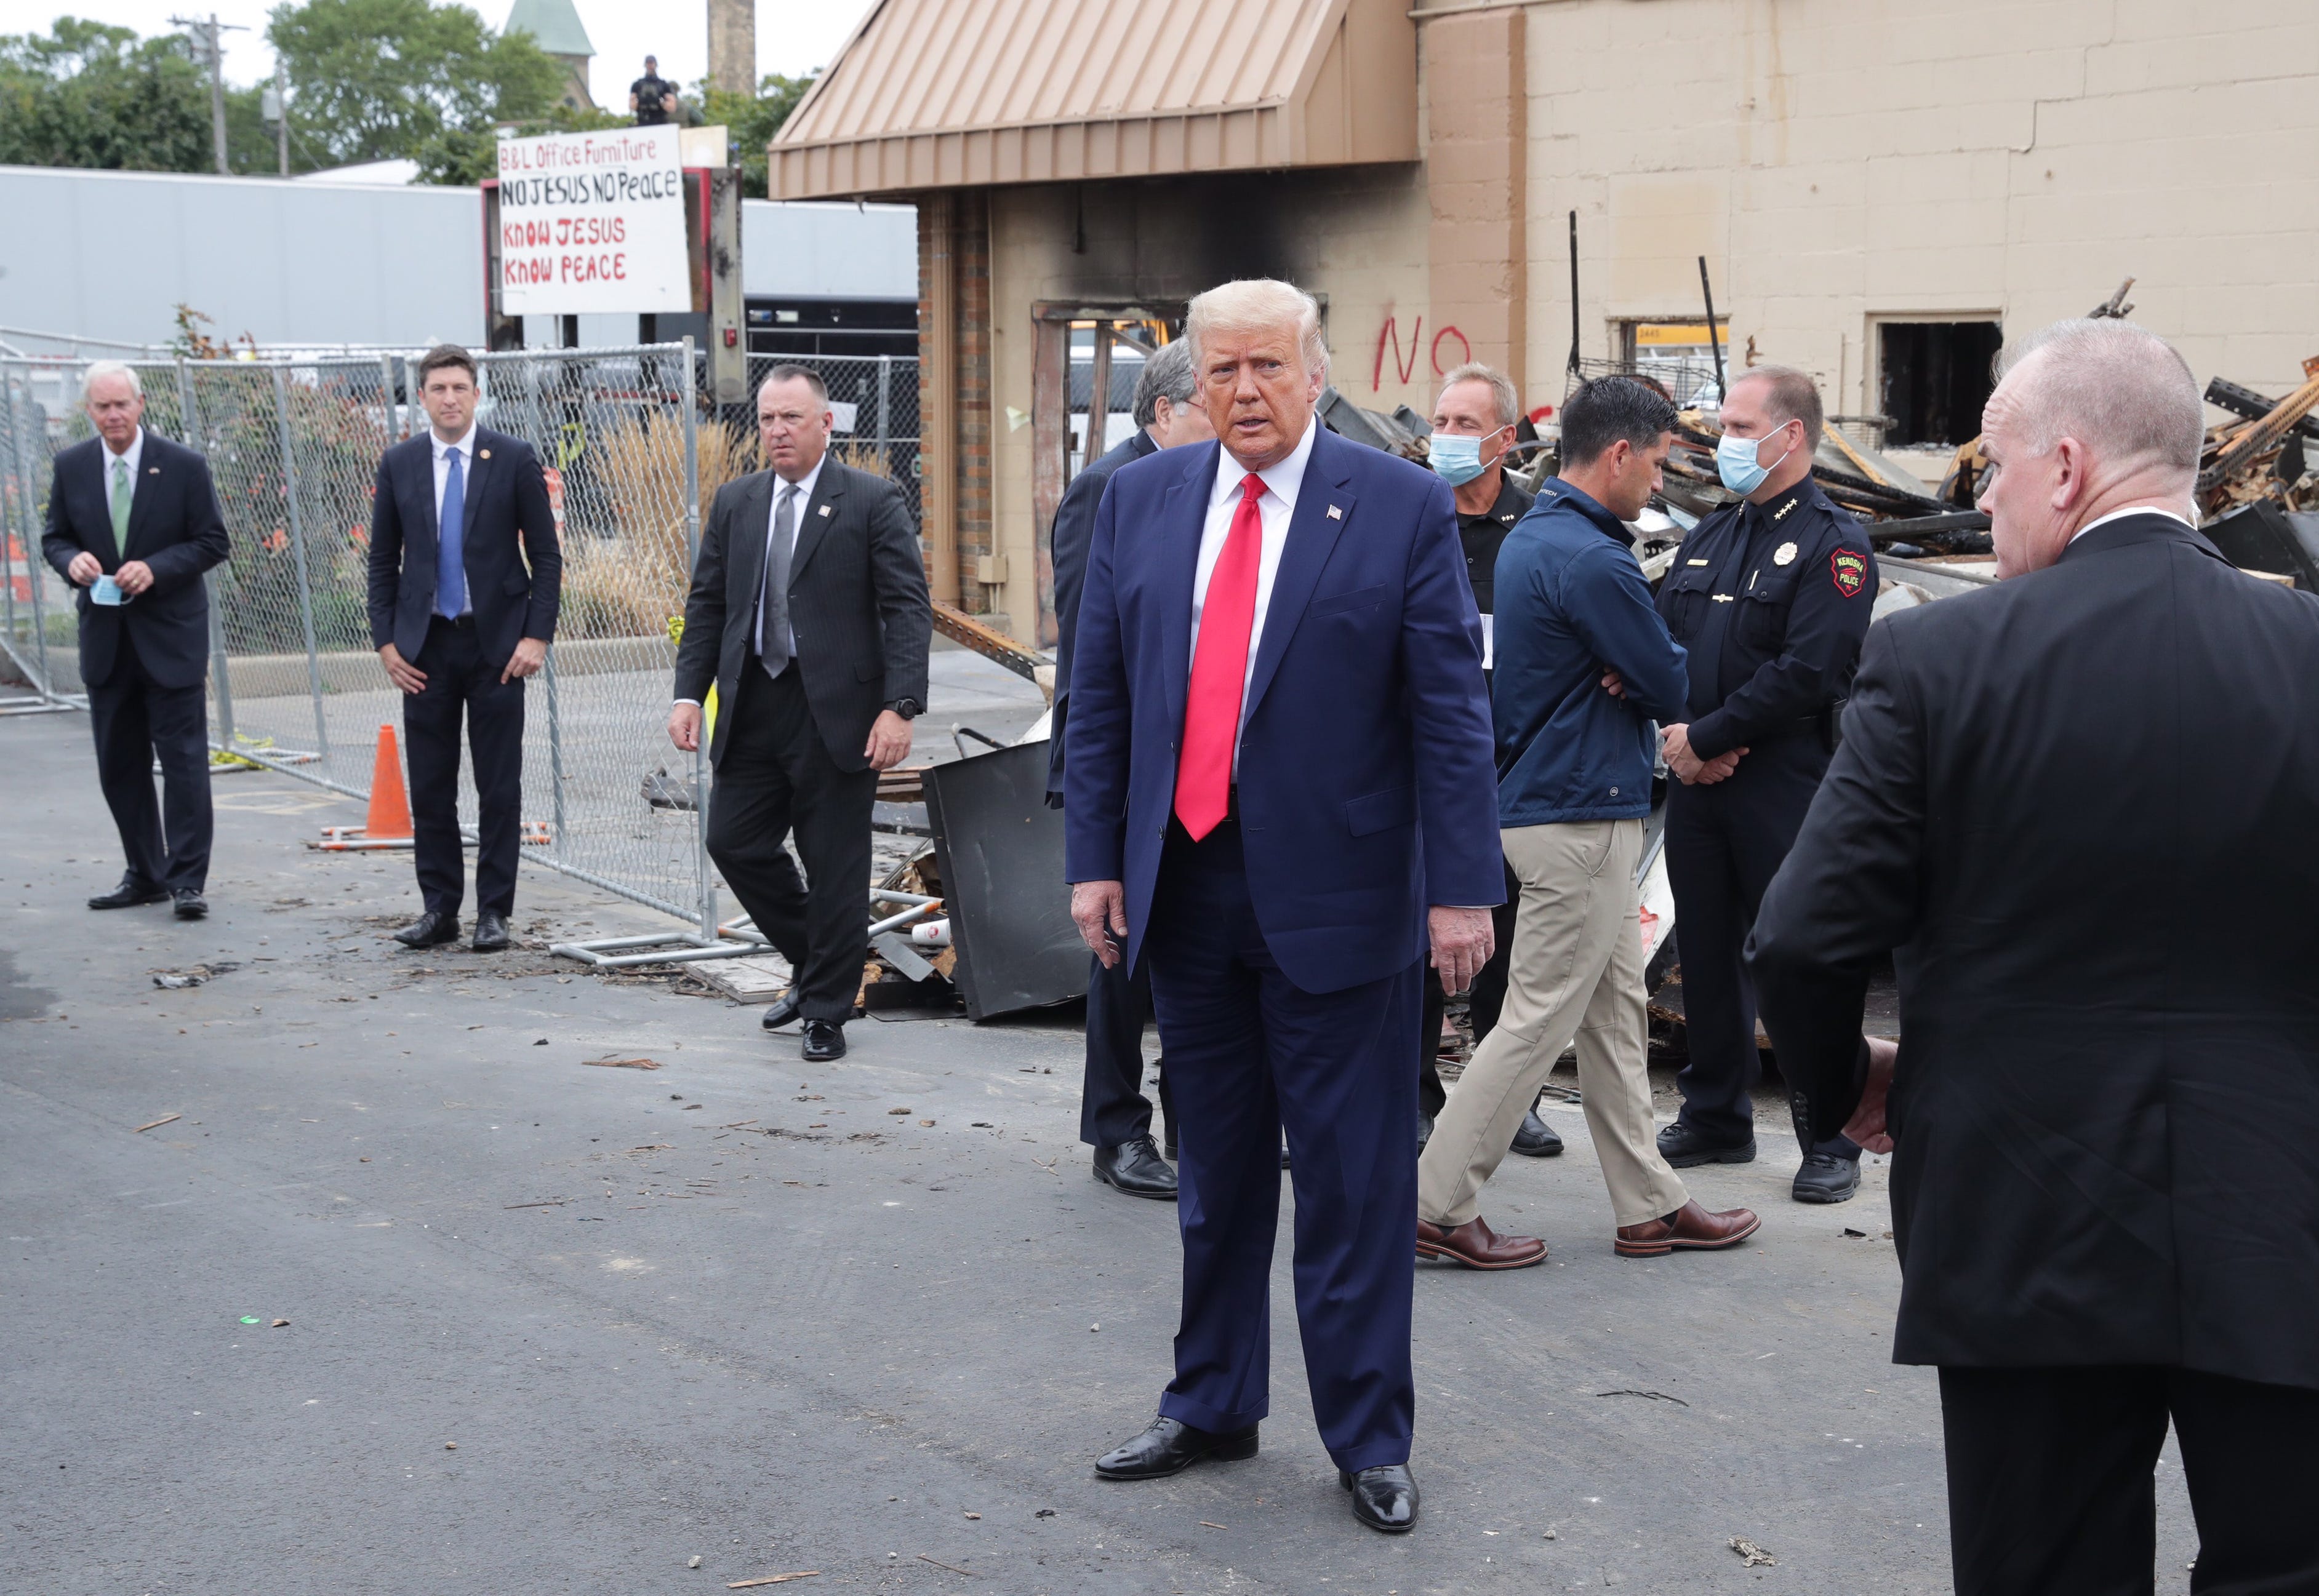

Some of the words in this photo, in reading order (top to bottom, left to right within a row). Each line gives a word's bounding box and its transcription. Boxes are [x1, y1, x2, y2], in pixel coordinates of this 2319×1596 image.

[500, 146, 531, 170] B&L
[536, 142, 580, 168] Office
[585, 136, 657, 164] Furniture
[502, 179, 527, 206] NO
[530, 174, 590, 205] JESUS
[593, 172, 615, 204] NO
[556, 217, 625, 245] JESUS
[562, 253, 626, 284] PEACE
[1373, 315, 1470, 392] NO
[1837, 557, 1864, 572] KENOSHA
[1840, 573, 1859, 586] POLICE
